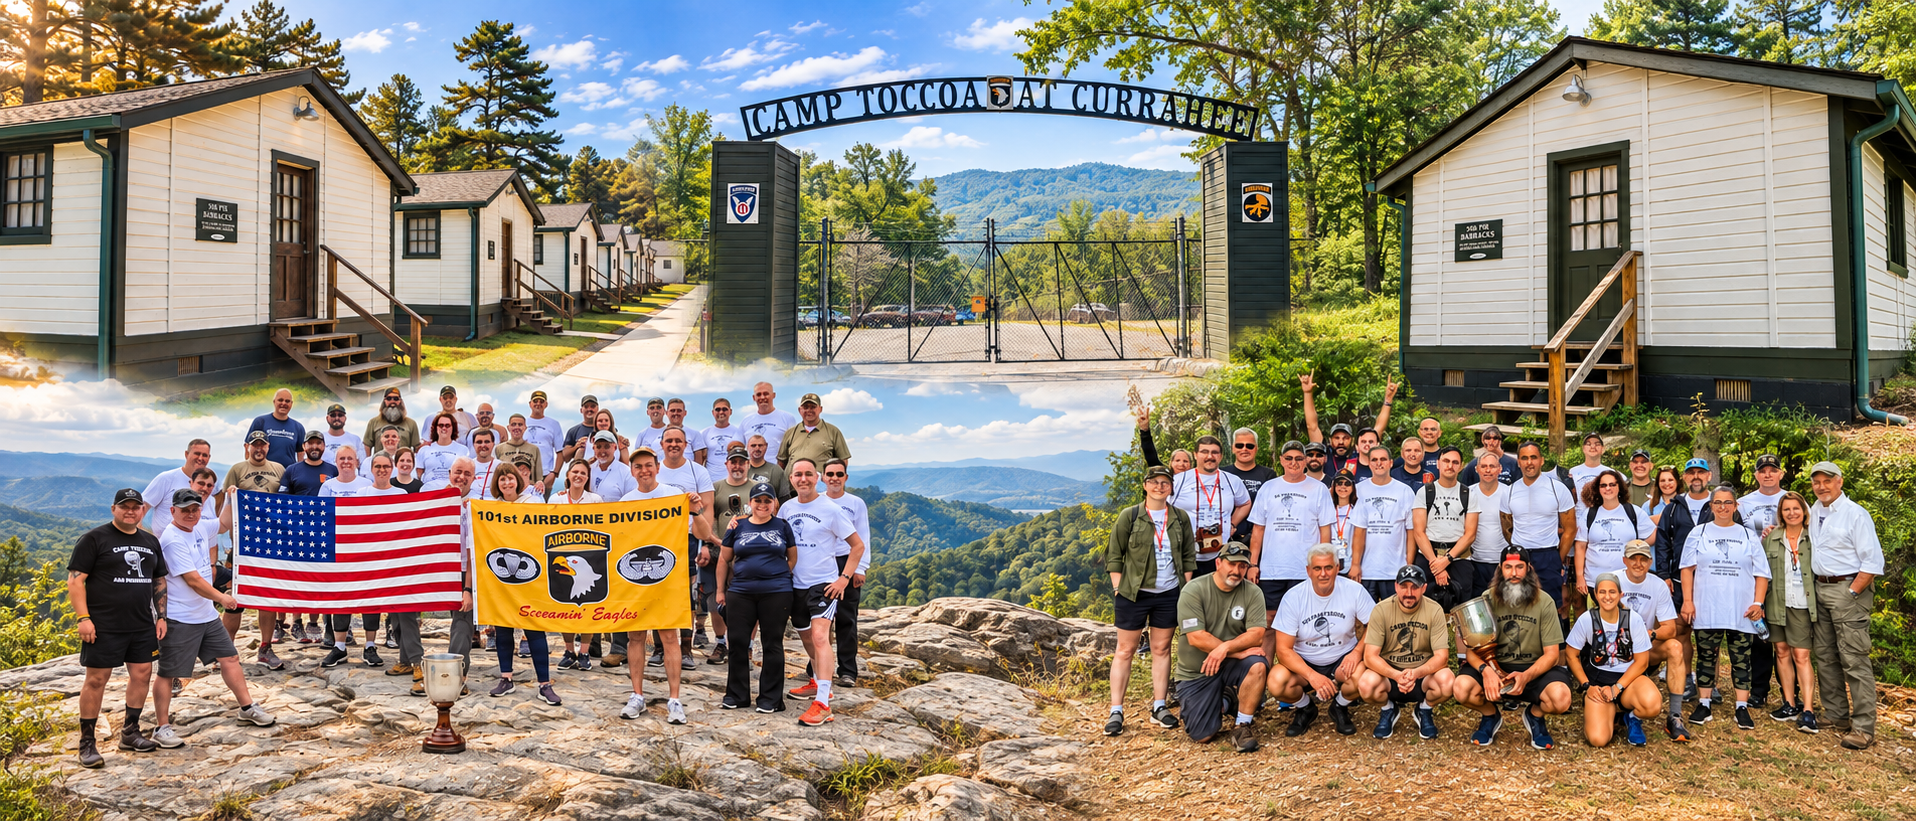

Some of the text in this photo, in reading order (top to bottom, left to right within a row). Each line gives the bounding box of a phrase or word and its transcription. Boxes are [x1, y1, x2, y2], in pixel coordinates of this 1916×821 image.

[752, 81, 1255, 137] CAMP TOCCOA AT CURRAHEE
[477, 505, 682, 525] 101st AIRBORNE DIVISION
[547, 532, 607, 547] AIRBORNE
[592, 606, 638, 624] Eagles
